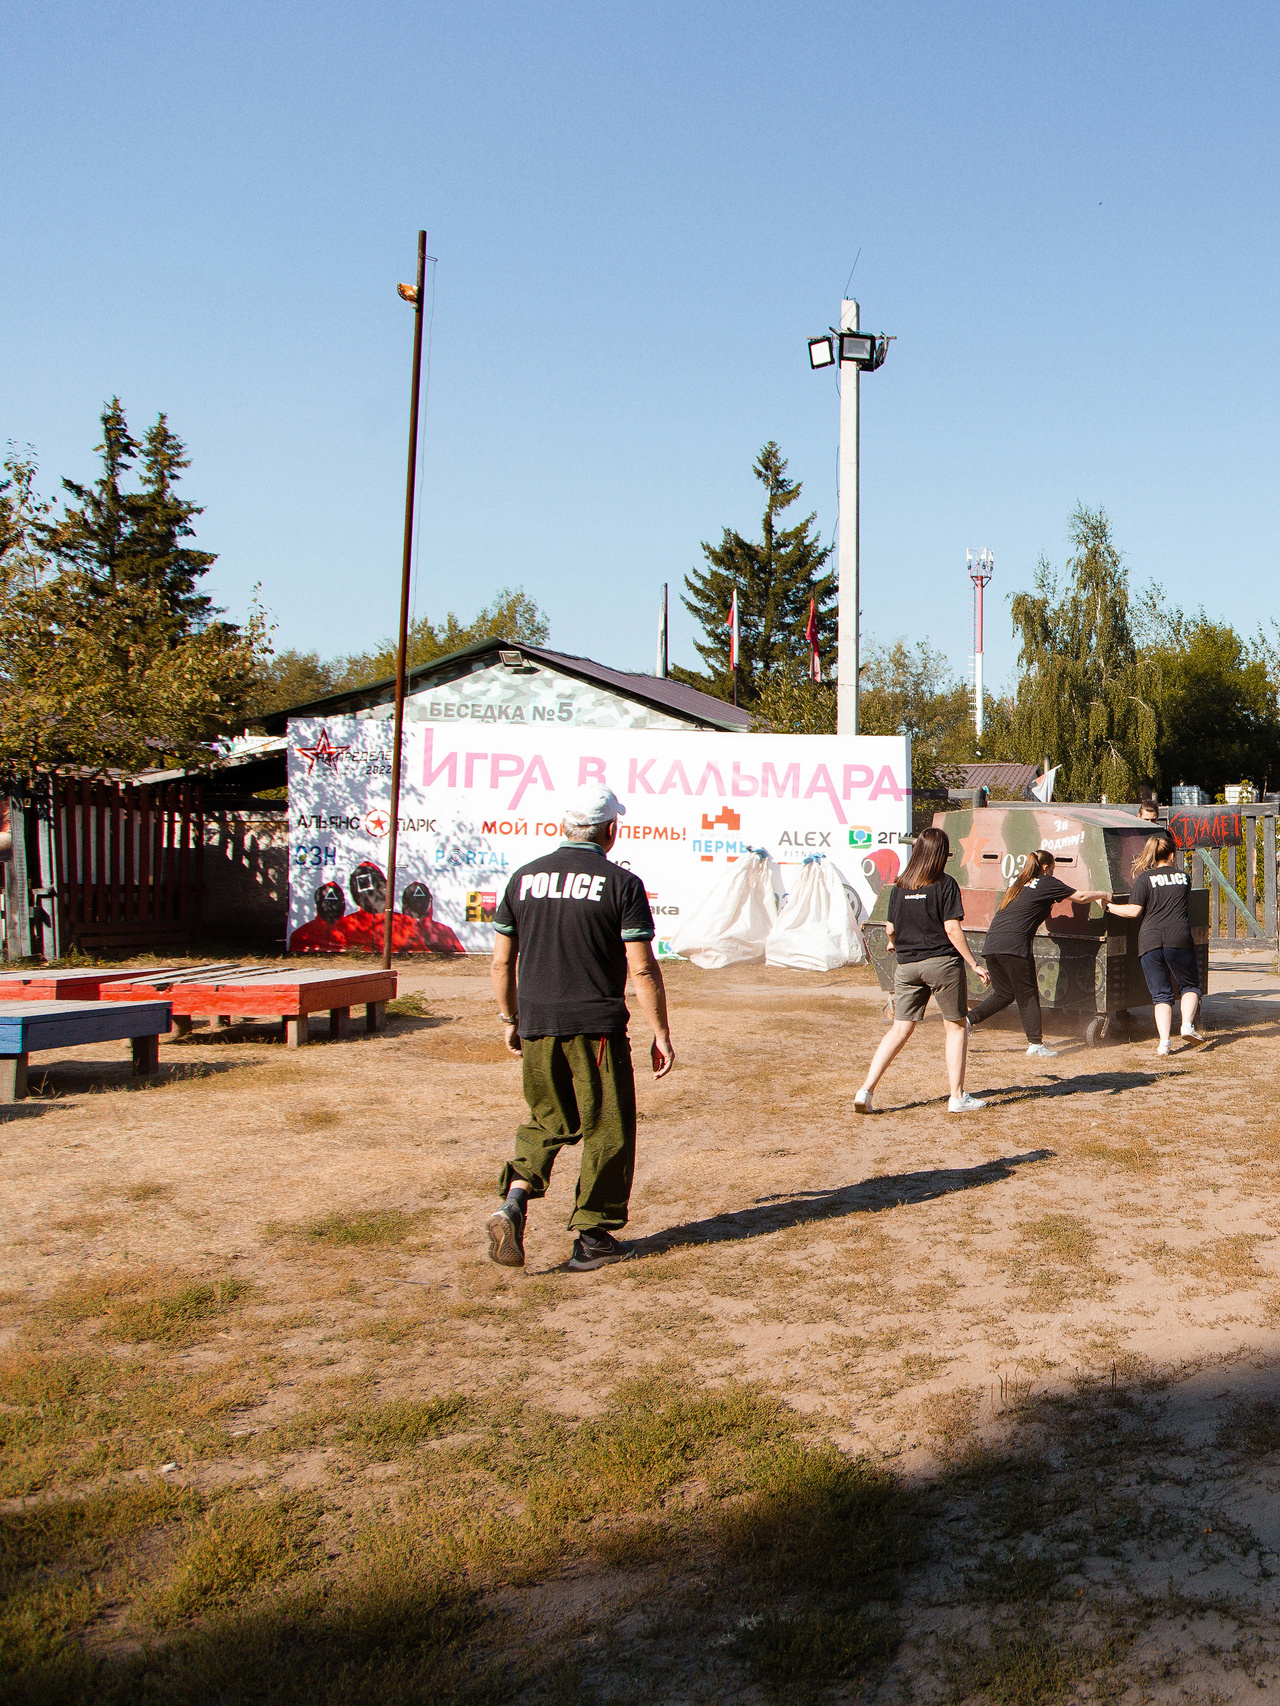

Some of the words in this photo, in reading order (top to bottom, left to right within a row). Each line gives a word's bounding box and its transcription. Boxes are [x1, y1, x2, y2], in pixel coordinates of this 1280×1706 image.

[429, 701, 525, 723] БЕСЕДКА
[532, 701, 574, 722] №5
[366, 765, 393, 775] 2022
[422, 727, 556, 811] ИГРА
[627, 757, 908, 825] КАЛЬМАРА
[297, 815, 361, 830] АЛЬЯНС
[396, 818, 437, 833] ПАРК
[481, 817, 528, 836] МОЙ
[618, 825, 687, 842] ПЕРМЬ!
[1178, 812, 1242, 841] ТУАЛЕТ
[692, 839, 748, 854] ПЕРМЬ
[778, 830, 832, 848] ALEX
[519, 872, 607, 902] POLICE
[1149, 872, 1189, 889] POLICE
